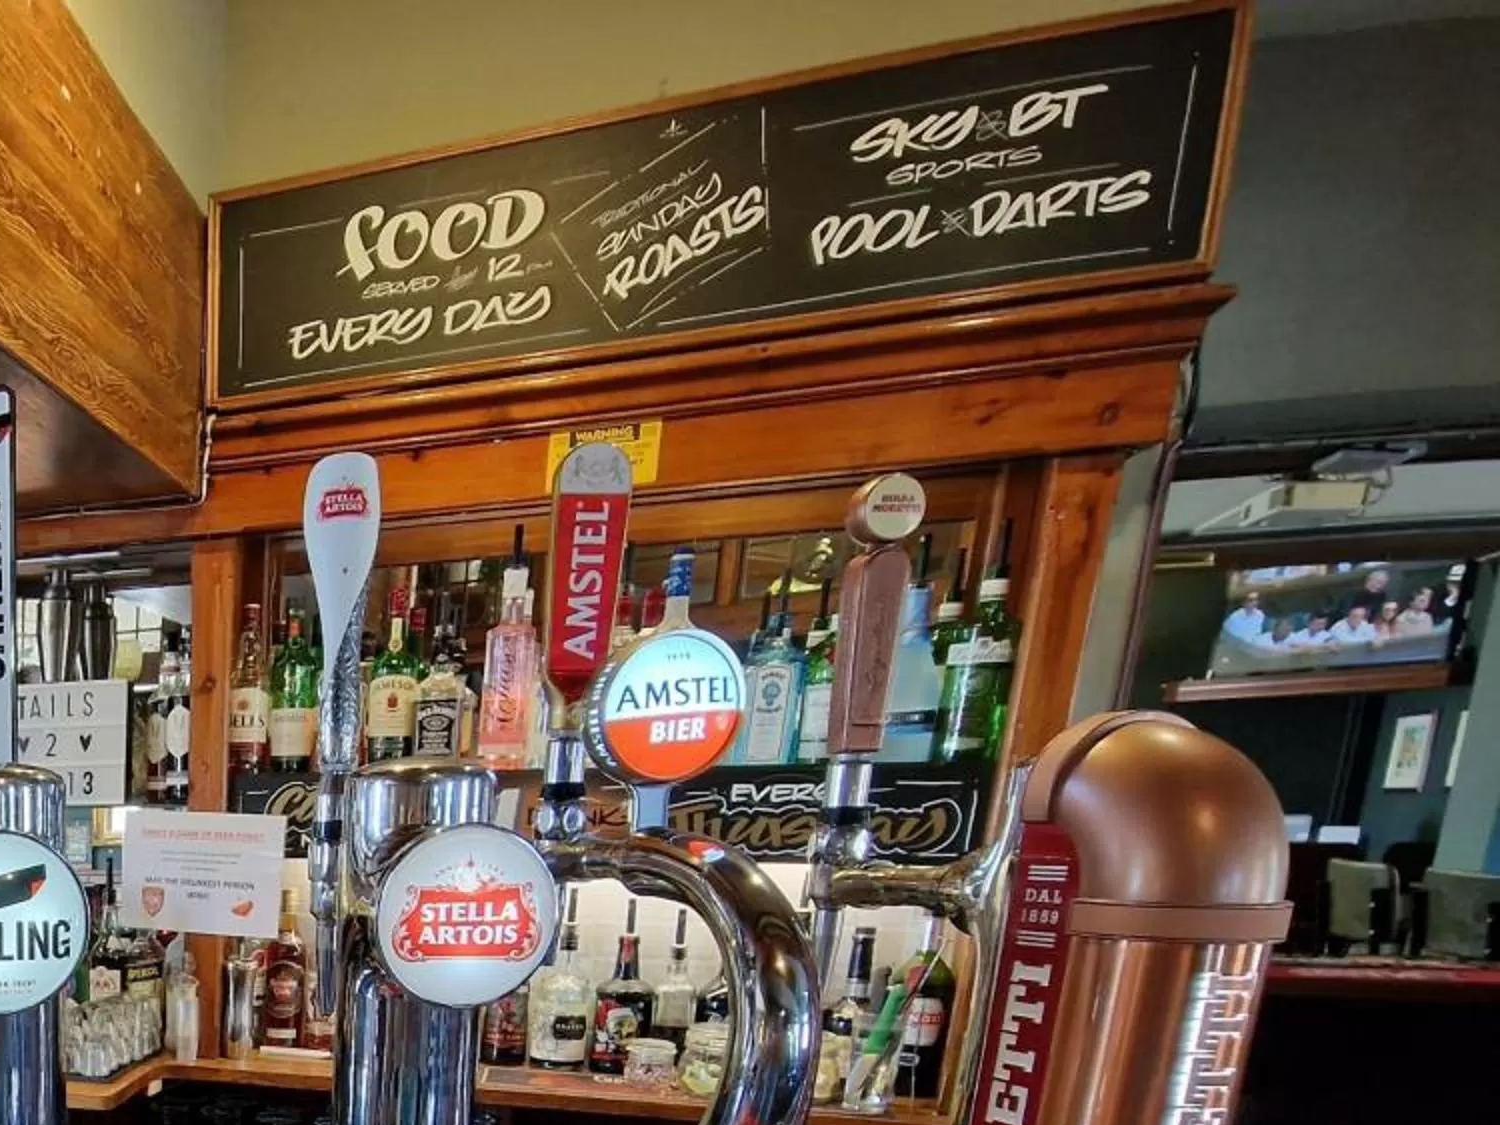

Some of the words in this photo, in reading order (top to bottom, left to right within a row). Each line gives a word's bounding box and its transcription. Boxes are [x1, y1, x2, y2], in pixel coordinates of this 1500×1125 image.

[850, 105, 980, 163] SKY
[1008, 83, 1109, 137] BT
[885, 144, 1043, 186] SPORTS
[596, 172, 722, 261] SUNDAY
[811, 204, 941, 266] POOL
[968, 170, 1152, 238] DARTS
[603, 185, 765, 300] ROASTS
[361, 275, 440, 300] SERVED
[487, 253, 525, 283] 12
[288, 305, 433, 360] EVERY
[443, 286, 551, 335] DAY
[564, 502, 610, 660] AMSTEL
[18, 691, 94, 720] TAILS
[615, 675, 733, 714] AMSTEL
[45, 733, 57, 757] 2
[649, 715, 707, 745] BIER
[67, 771, 94, 795] 13
[419, 901, 519, 922] STELLA
[1024, 888, 1062, 905] DAL
[418, 924, 518, 945] ARTOIS
[1020, 909, 1059, 925] 1859
